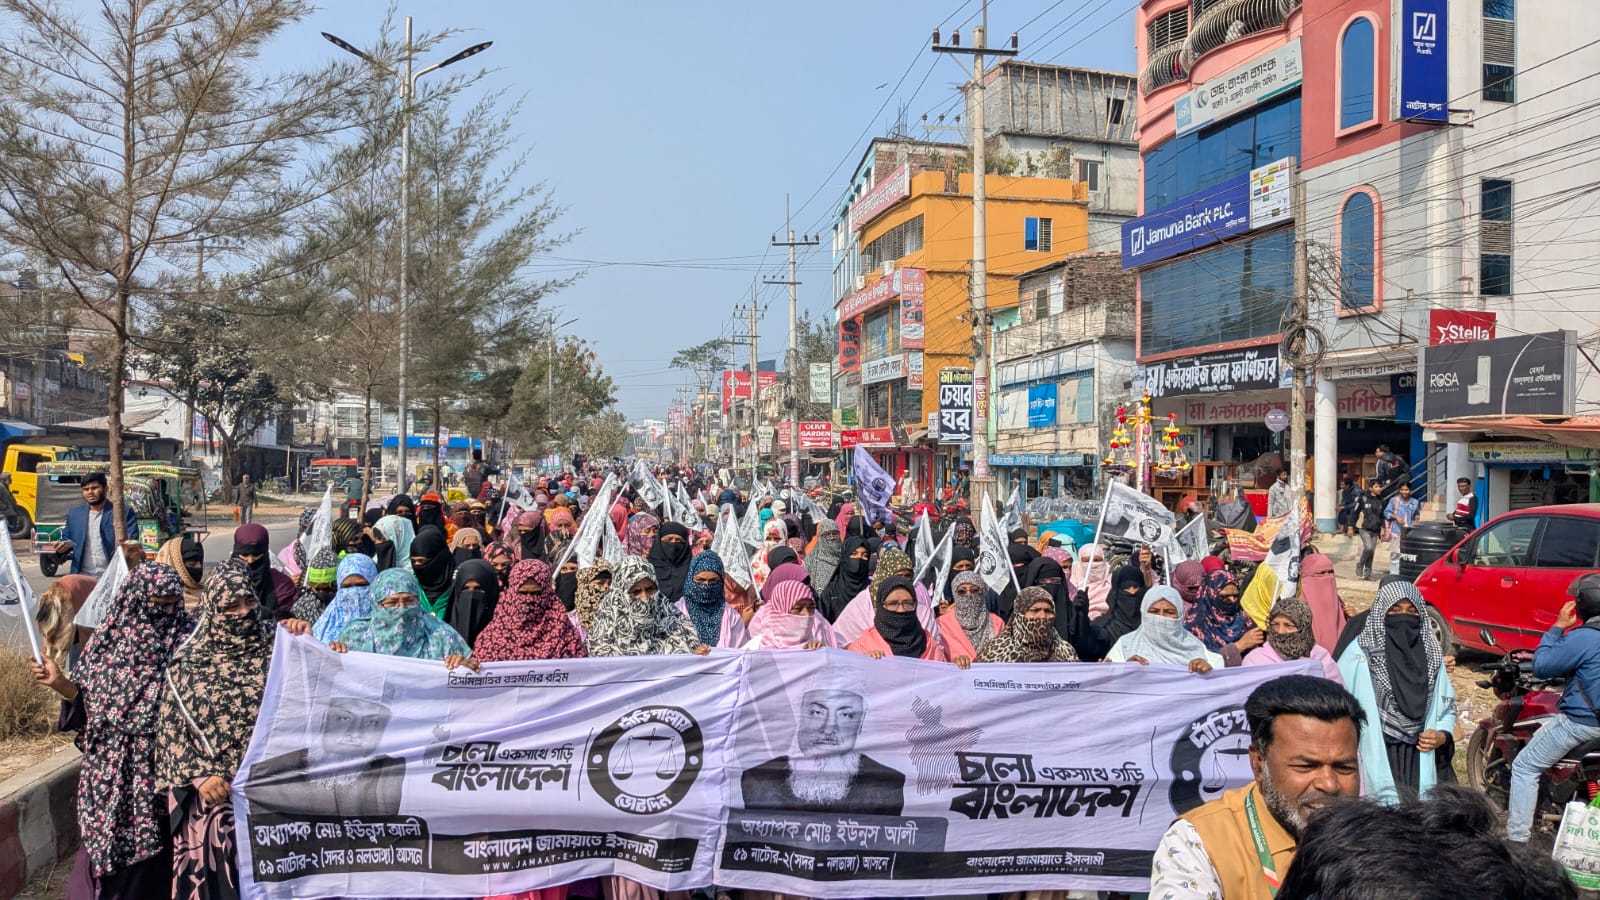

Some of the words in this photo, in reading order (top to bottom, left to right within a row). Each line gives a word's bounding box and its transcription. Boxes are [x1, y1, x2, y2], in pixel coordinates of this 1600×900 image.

[1250, 57, 1277, 79] ব্যাংক
[1145, 220, 1184, 246] Jamuna
[1185, 207, 1212, 233] Bank
[1213, 202, 1234, 222] PLC.
[1449, 325, 1490, 340] Stella
[1146, 363, 1167, 397] মা
[1165, 360, 1210, 391] এন্টারপ্রাইজ
[1430, 372, 1459, 388] ROSA
[940, 385, 973, 408] চেয়ার
[940, 409, 971, 432] ঘর
[1189, 402, 1206, 421] মা
[448, 672, 501, 686] বিসমিল্লাহির
[545, 669, 569, 683] রহিম
[441, 741, 501, 763] চলো
[498, 747, 549, 761] একসাথে
[551, 743, 575, 763] গড়ি
[431, 763, 573, 791] বাংলাদেশ
[954, 751, 1035, 783] চলো
[1038, 766, 1108, 782] একসাথে
[1111, 761, 1145, 784] গড়ি
[949, 783, 1142, 819] বাংলাদেশ
[254, 821, 312, 847] অধ্যাপক
[315, 823, 343, 840] মোঃ
[344, 819, 385, 844] ইউনুস
[386, 817, 422, 837] আলী
[741, 818, 802, 839] অধ্যাপক
[804, 821, 832, 842] মোঃ
[836, 818, 880, 849] ইউনুস
[884, 820, 919, 846] আলী
[463, 836, 533, 859] বাংলাদেশ
[536, 835, 603, 853] জামায়াতে
[606, 833, 659, 859] ইসলামী
[258, 860, 274, 875] ৫৯
[347, 854, 353, 865] ও
[396, 847, 423, 866] আসনে
[483, 850, 638, 872] WWW.JAMAAT-E-ISLAMI.ORG
[733, 849, 747, 861] ৫৯
[863, 856, 890, 870] আসনে
[966, 854, 1014, 867] বাংলাদেশ
[1016, 854, 1063, 866] জামায়াতে
[1065, 851, 1105, 866] ইসলামী
